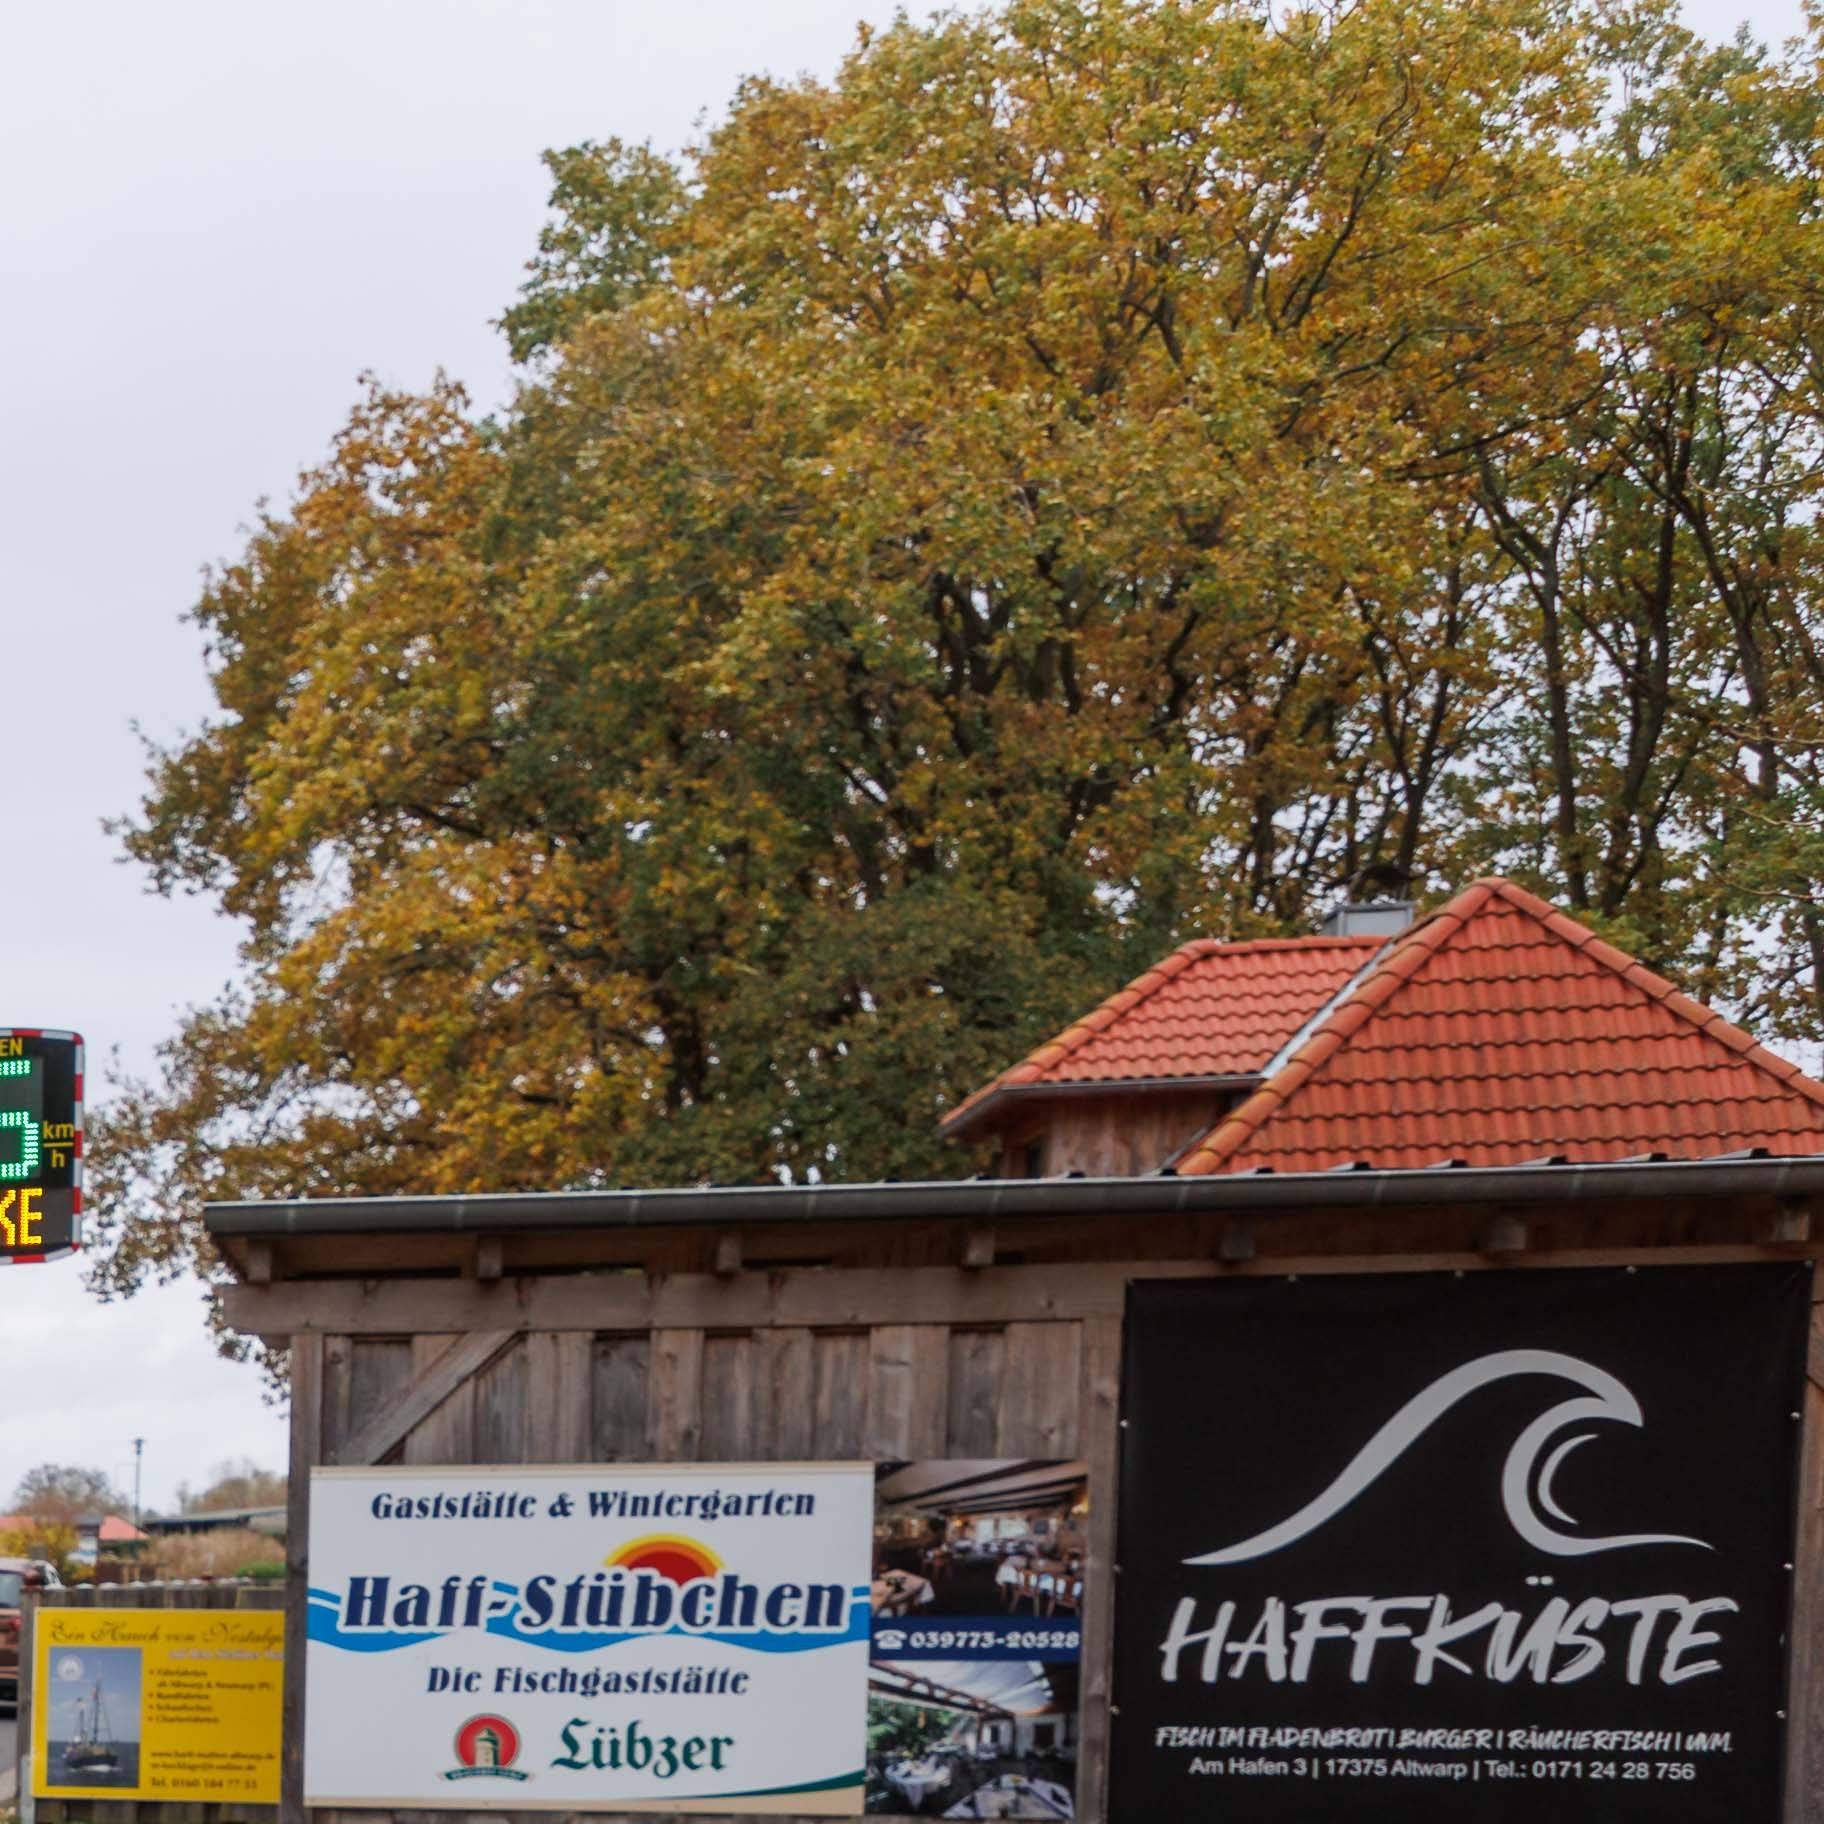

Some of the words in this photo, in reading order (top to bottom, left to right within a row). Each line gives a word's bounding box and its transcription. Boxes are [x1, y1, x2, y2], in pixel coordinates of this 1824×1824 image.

[43, 1121, 74, 1140] km
[51, 1150, 65, 1168] h
[371, 1491, 537, 1519] Gaststätte
[548, 1493, 574, 1518] &
[588, 1489, 815, 1521] Wintergarten
[343, 1573, 848, 1629] Haff-Stübchen
[909, 1631, 1080, 1649] 039773-20528
[1159, 1575, 1740, 1685] HAFFKÜSTE
[427, 1667, 482, 1693] Die
[494, 1666, 749, 1697] Fischgaststätte
[551, 1717, 734, 1779] Lübzer
[1156, 1726, 1216, 1747] FISCH
[1217, 1727, 1246, 1747] IM
[1247, 1727, 1388, 1749] FLADENBROT
[1396, 1728, 1493, 1749] BURGER
[1507, 1726, 1672, 1751] RÄUCHERFISCH
[1188, 1757, 1224, 1775] Am
[1229, 1757, 1289, 1775] Hafen
[1293, 1758, 1308, 1776] 3
[1325, 1758, 1388, 1776] 17375
[1390, 1759, 1468, 1780] Altwarp
[1484, 1760, 1527, 1778] Tel.:
[1531, 1760, 1583, 1778] 0171
[1589, 1761, 1617, 1779] 24
[1621, 1762, 1650, 1779] 28
[1655, 1762, 1696, 1780] 756
